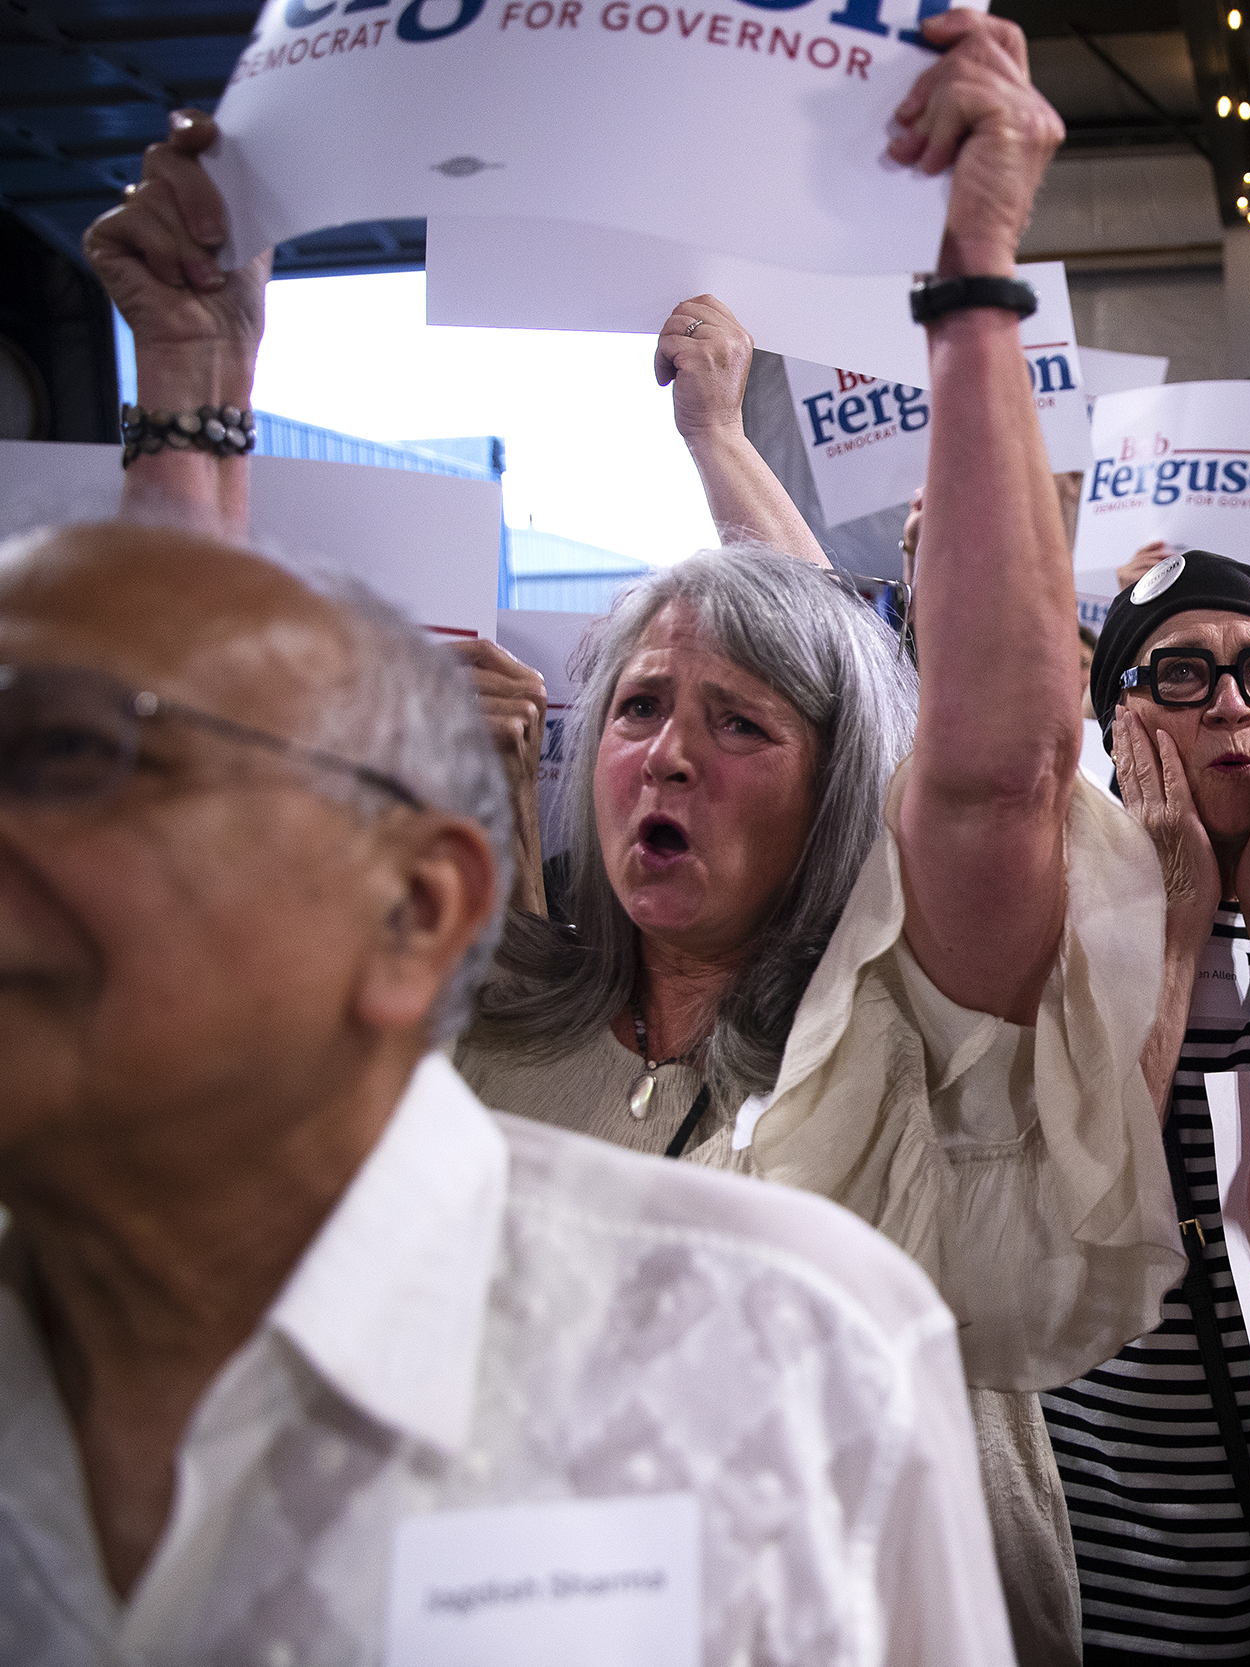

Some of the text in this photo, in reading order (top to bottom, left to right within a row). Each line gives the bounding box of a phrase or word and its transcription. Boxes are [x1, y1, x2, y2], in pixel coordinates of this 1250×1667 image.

[500, 1, 583, 32] FOR
[601, 2, 874, 80] GOVERNOR
[826, 425, 898, 459] DEMOCRAT
[1185, 494, 1213, 506] FOR
[1211, 970, 1237, 980] Allen
